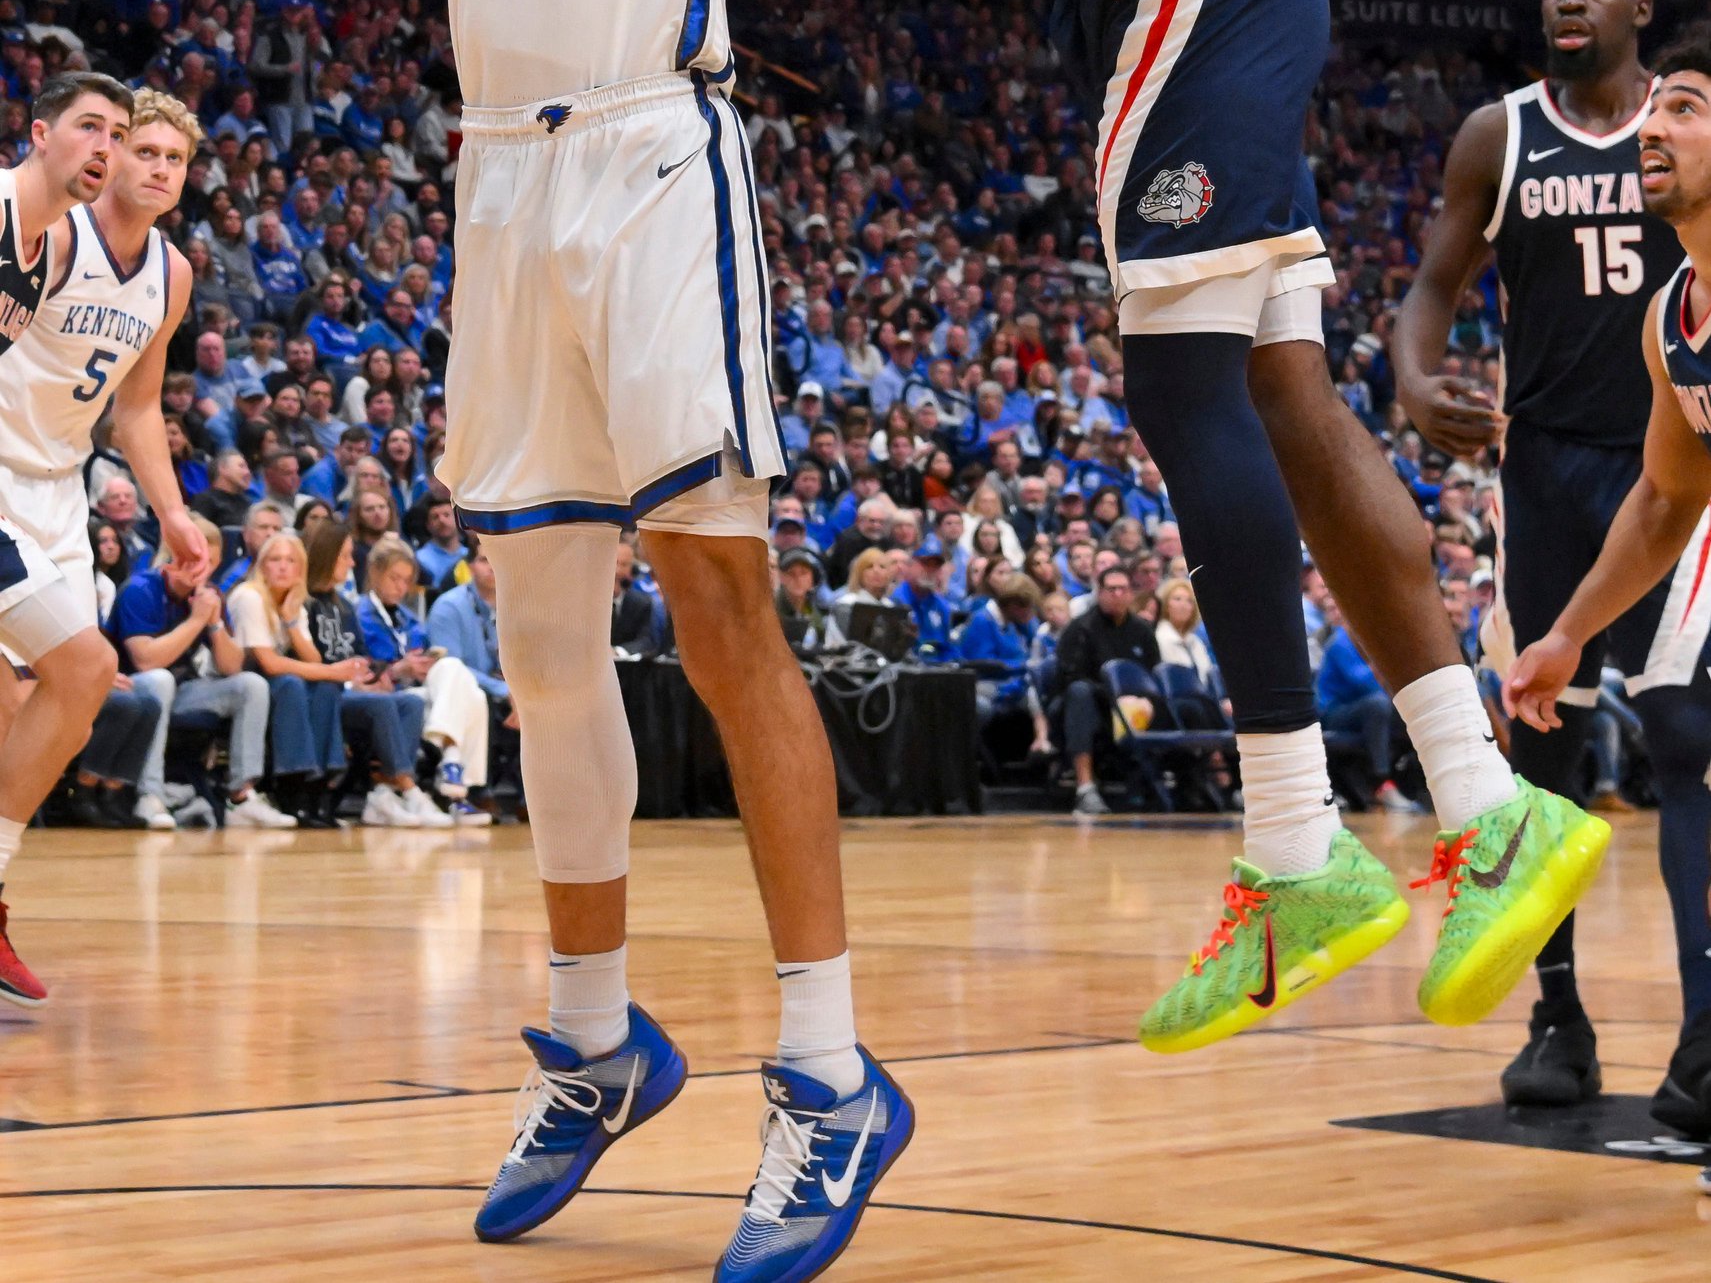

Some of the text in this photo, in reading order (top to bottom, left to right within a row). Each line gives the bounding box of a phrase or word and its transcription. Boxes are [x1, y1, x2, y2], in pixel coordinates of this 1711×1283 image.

[1342, 0, 1513, 30] SUITE LEVEL
[1574, 225, 1644, 296] 15
[72, 348, 118, 402] 5
